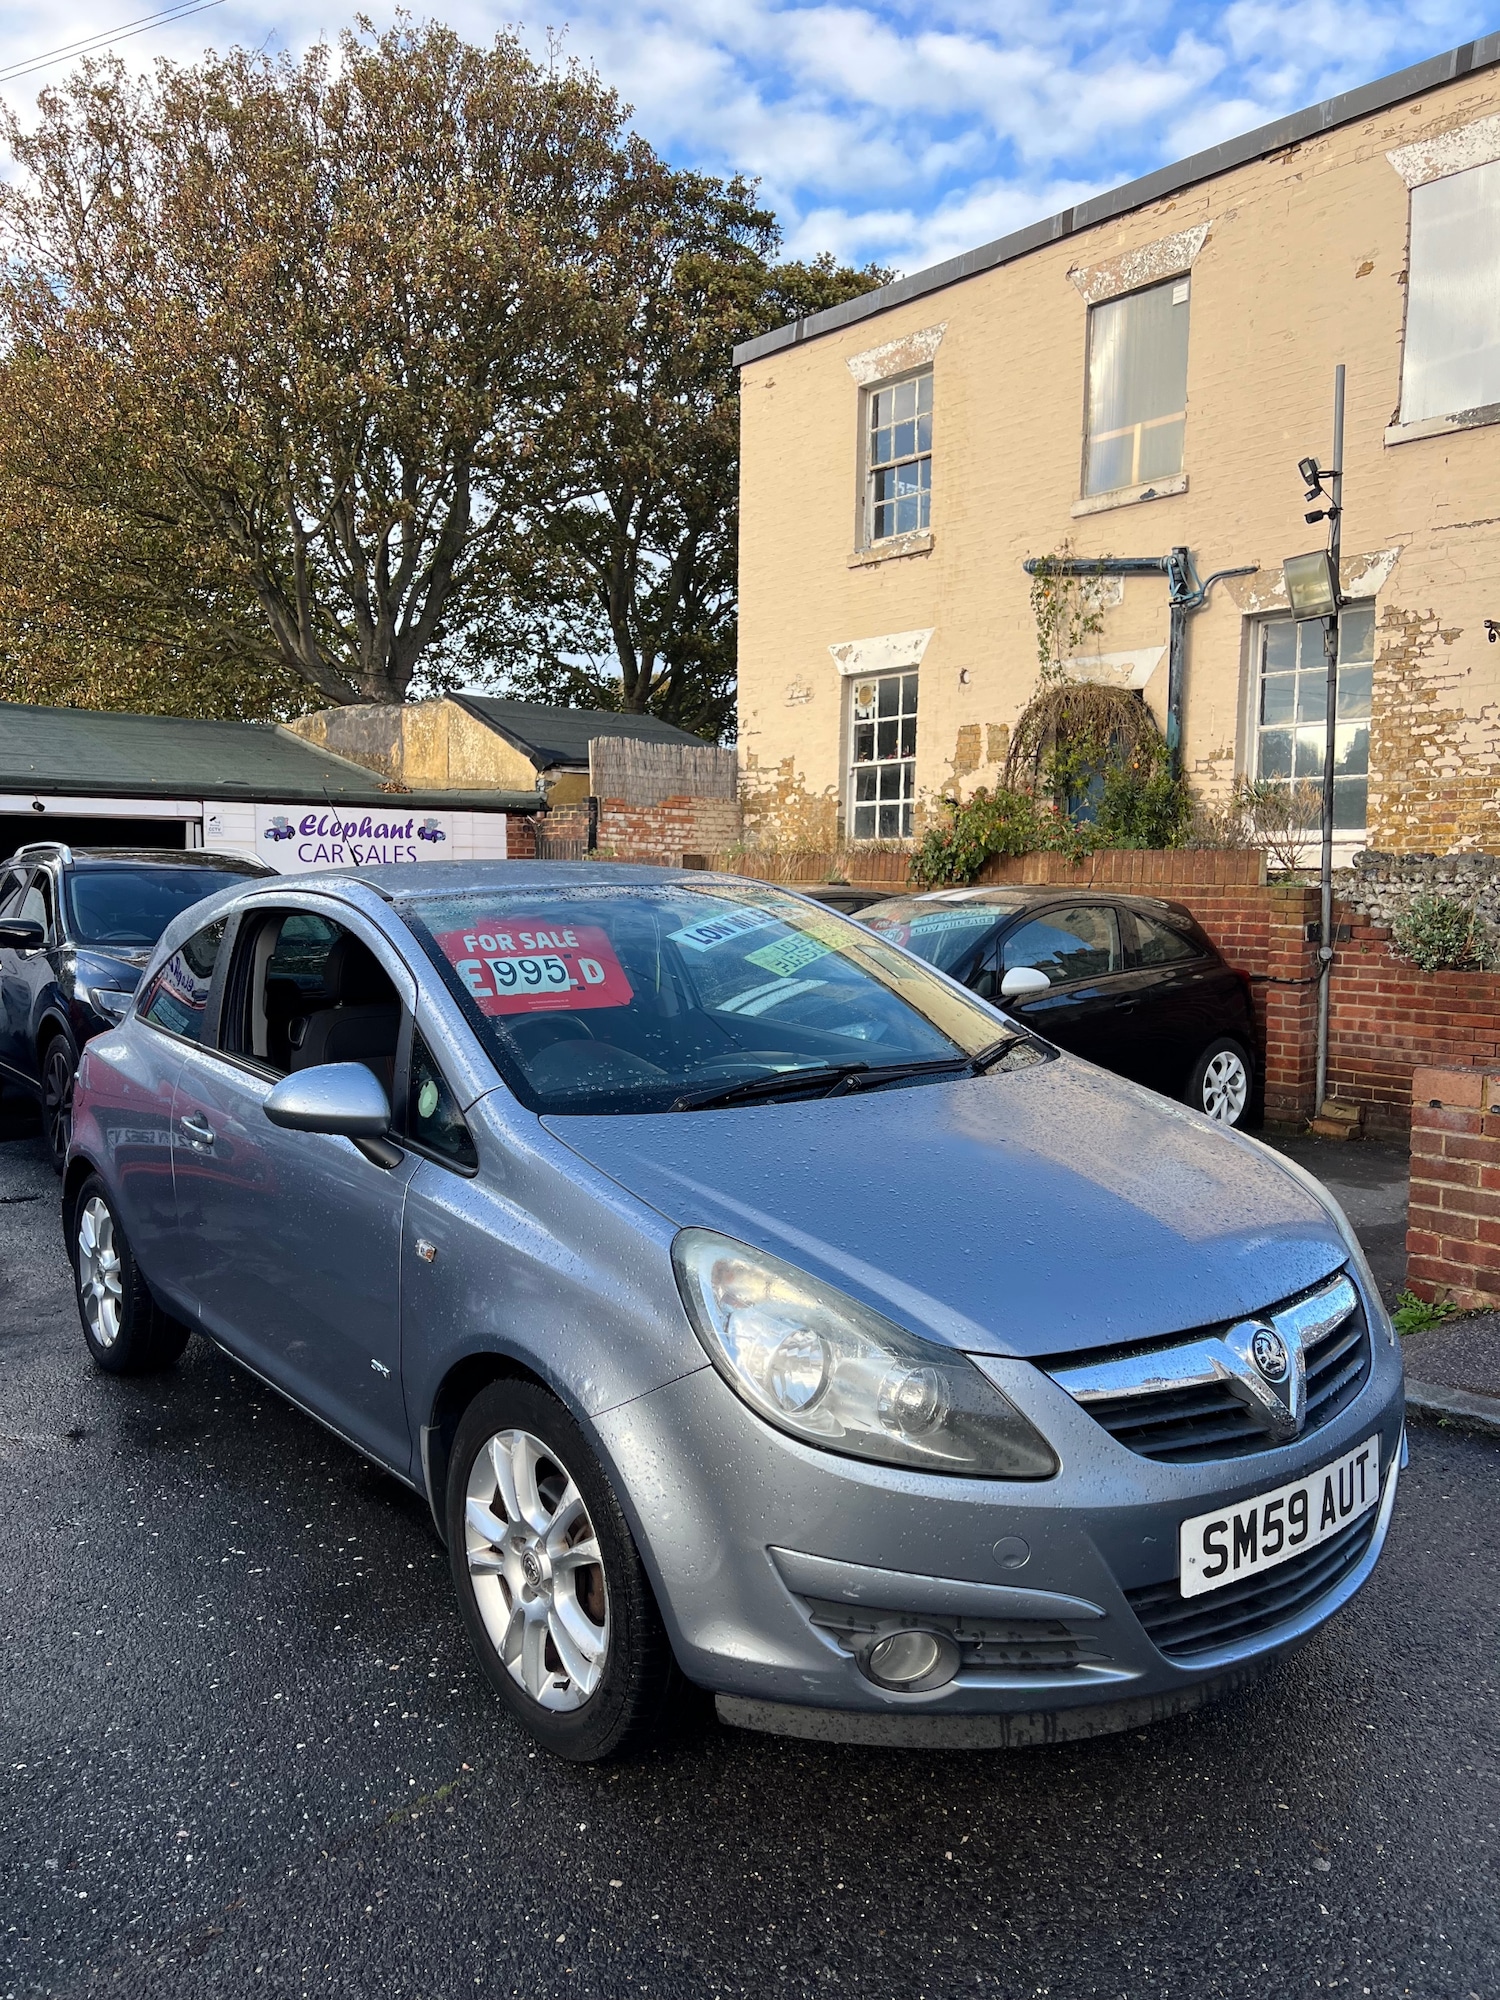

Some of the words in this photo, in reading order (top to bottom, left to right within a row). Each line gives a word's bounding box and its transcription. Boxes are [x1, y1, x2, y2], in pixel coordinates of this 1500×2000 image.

[299, 814, 414, 842] Elephant
[297, 843, 344, 863] CAR
[353, 844, 417, 864] SALES
[463, 934, 517, 952] FOR
[519, 930, 579, 949] SALE
[684, 921, 736, 945] LOW
[1202, 1489, 1308, 1579] SM59
[1320, 1450, 1370, 1531] AUT
